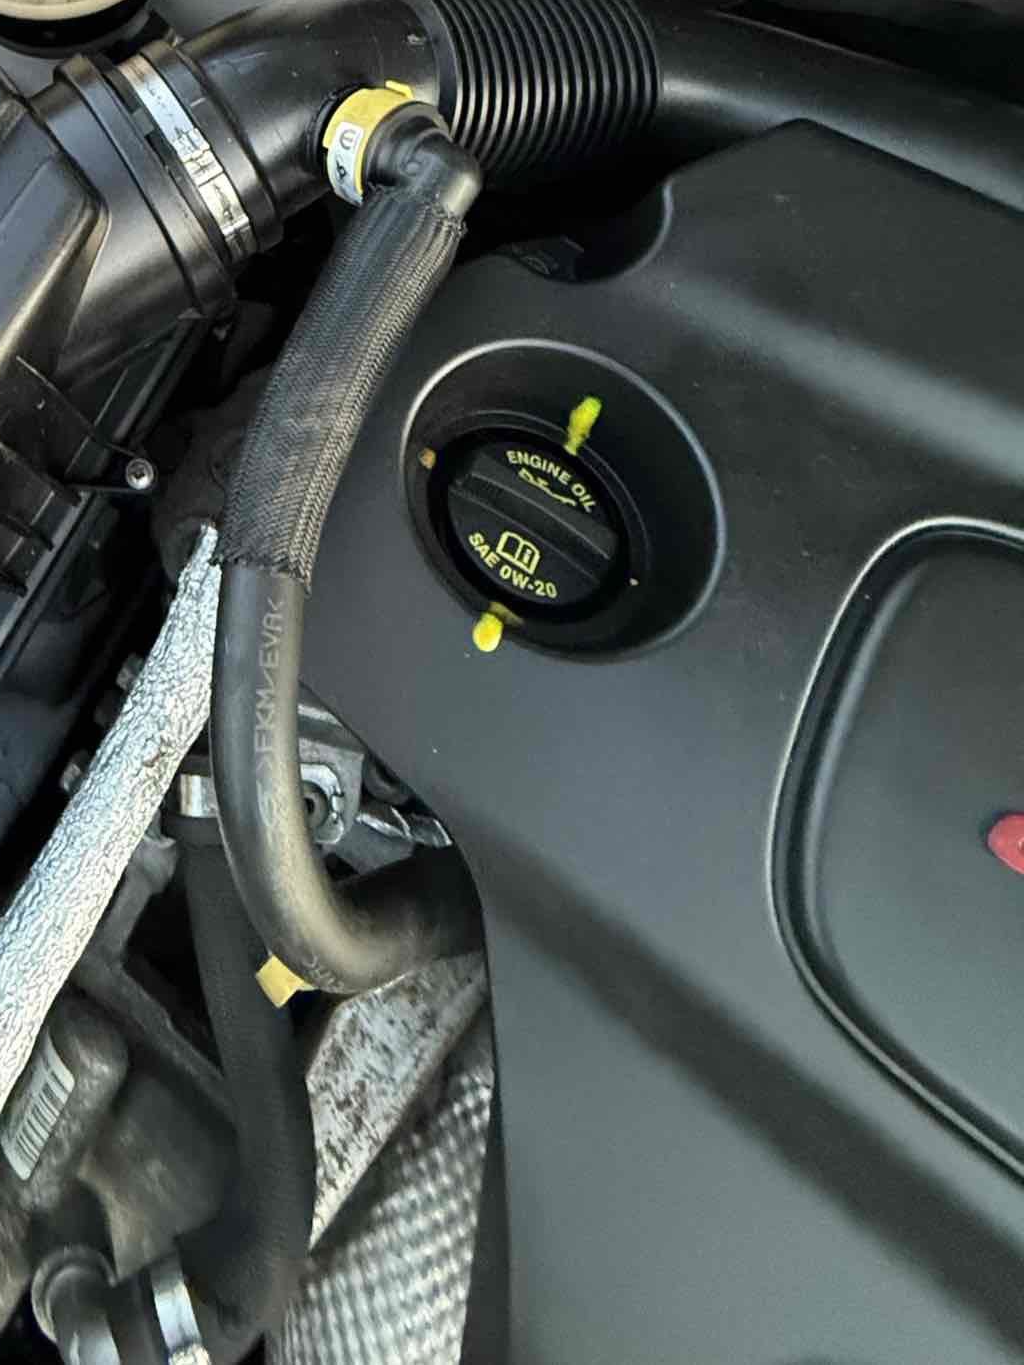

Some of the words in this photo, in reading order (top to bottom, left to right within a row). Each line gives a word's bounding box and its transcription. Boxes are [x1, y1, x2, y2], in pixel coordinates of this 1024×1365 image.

[506, 450, 572, 485] ENGINE
[571, 483, 597, 514] OIL
[468, 532, 501, 569] SAE
[499, 565, 558, 599] 0W-20
